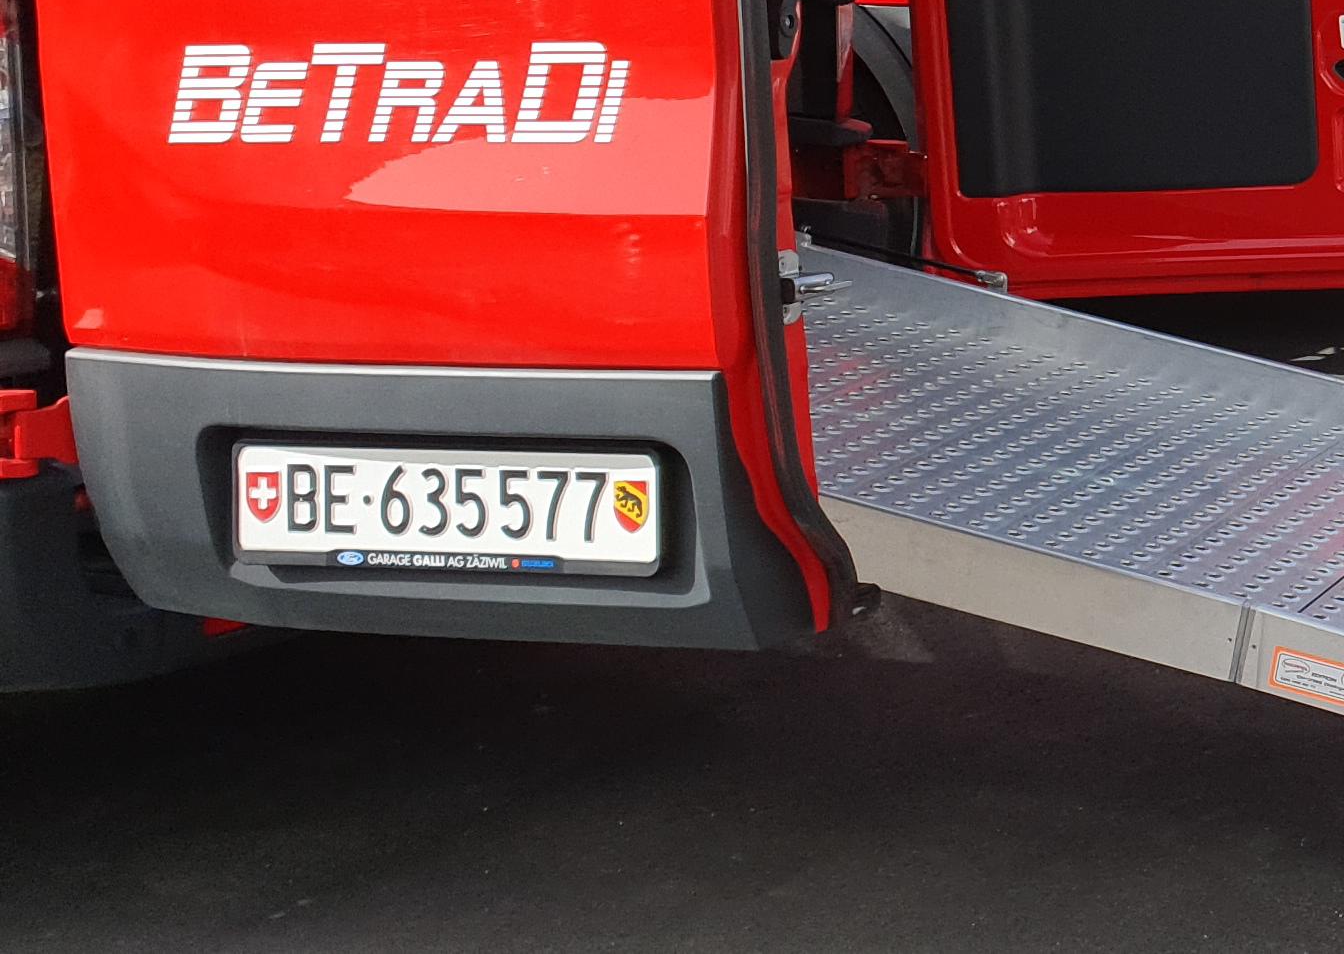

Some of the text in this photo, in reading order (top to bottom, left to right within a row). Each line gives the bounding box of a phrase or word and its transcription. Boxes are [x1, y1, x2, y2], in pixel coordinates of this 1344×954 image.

[367, 553, 411, 566] GARAGE
[413, 554, 445, 567] GALLI
[447, 556, 464, 568] AG
